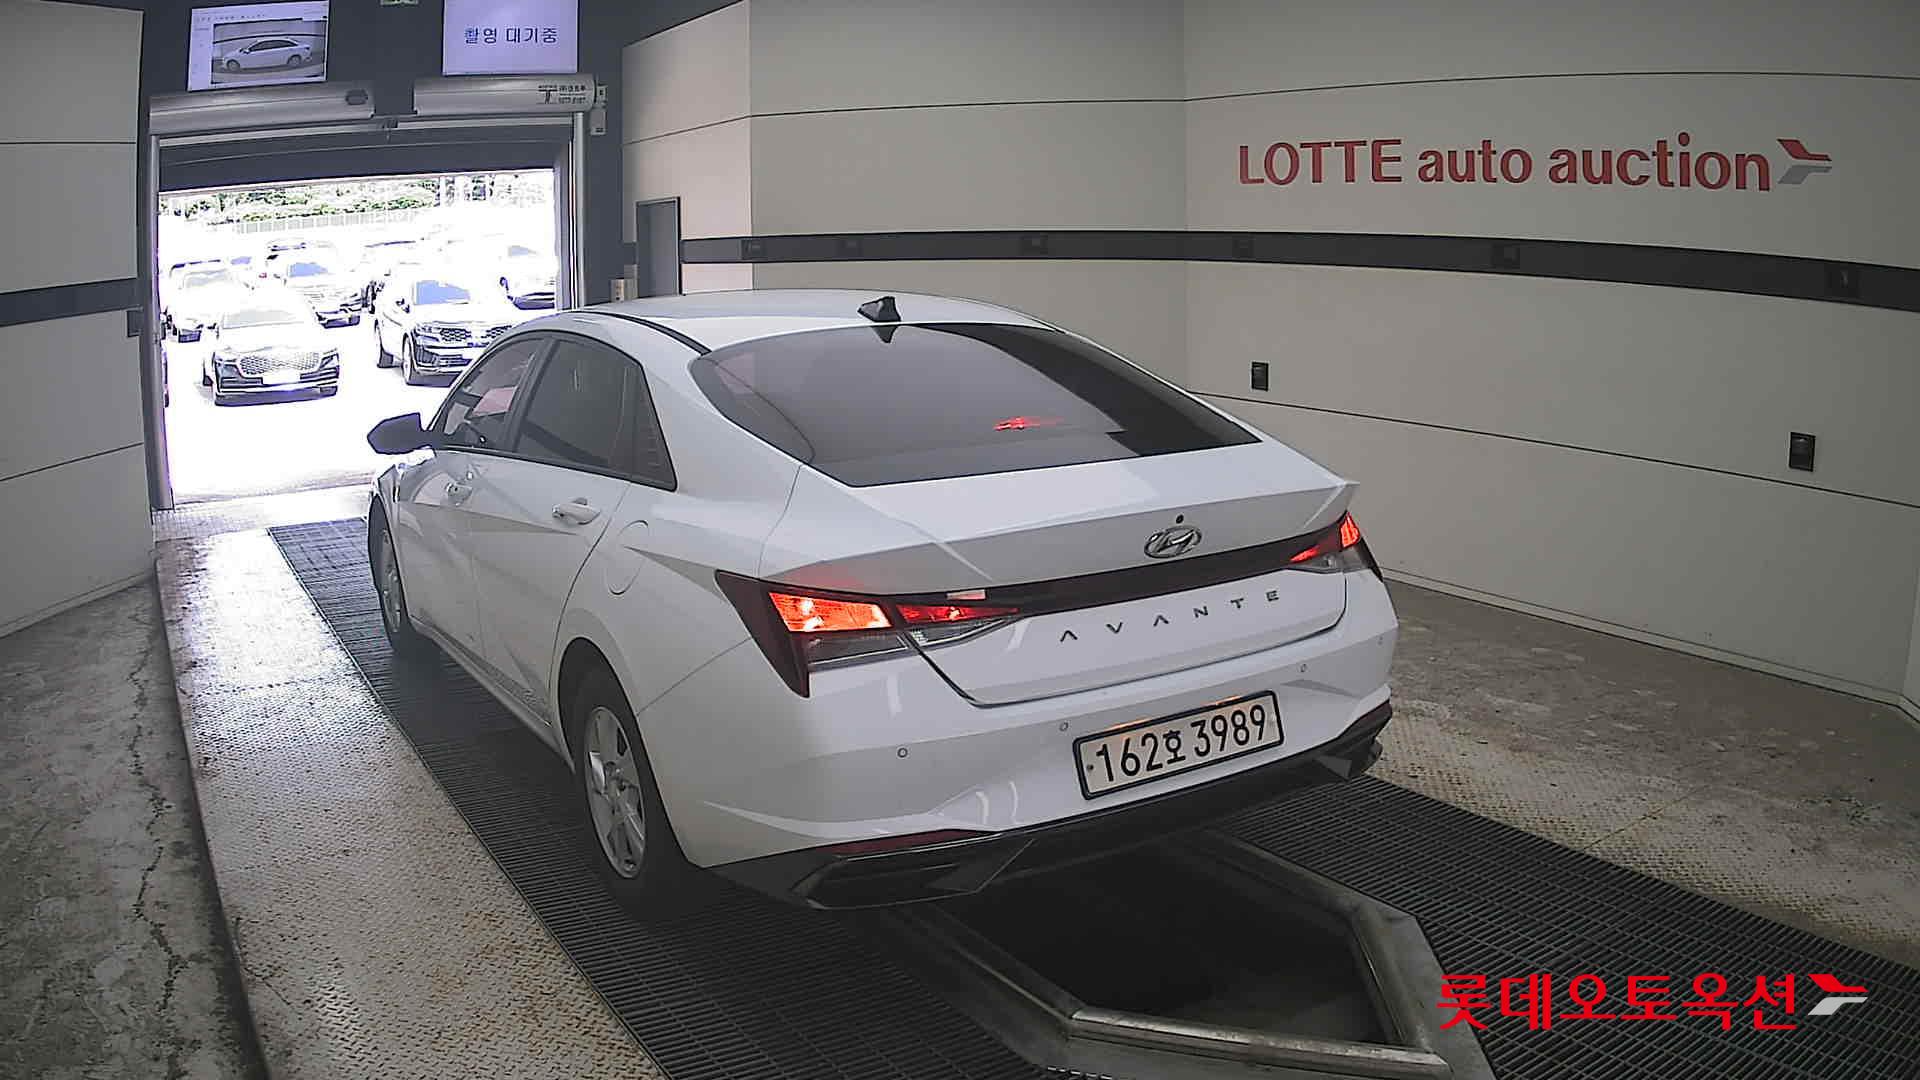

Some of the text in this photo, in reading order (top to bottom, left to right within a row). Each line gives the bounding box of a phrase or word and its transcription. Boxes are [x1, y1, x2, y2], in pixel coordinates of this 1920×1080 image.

[464, 27, 557, 44] 촬영 대기중
[1239, 132, 1770, 191] LOTTE auto auction
[1060, 590, 1279, 642] AVANTE
